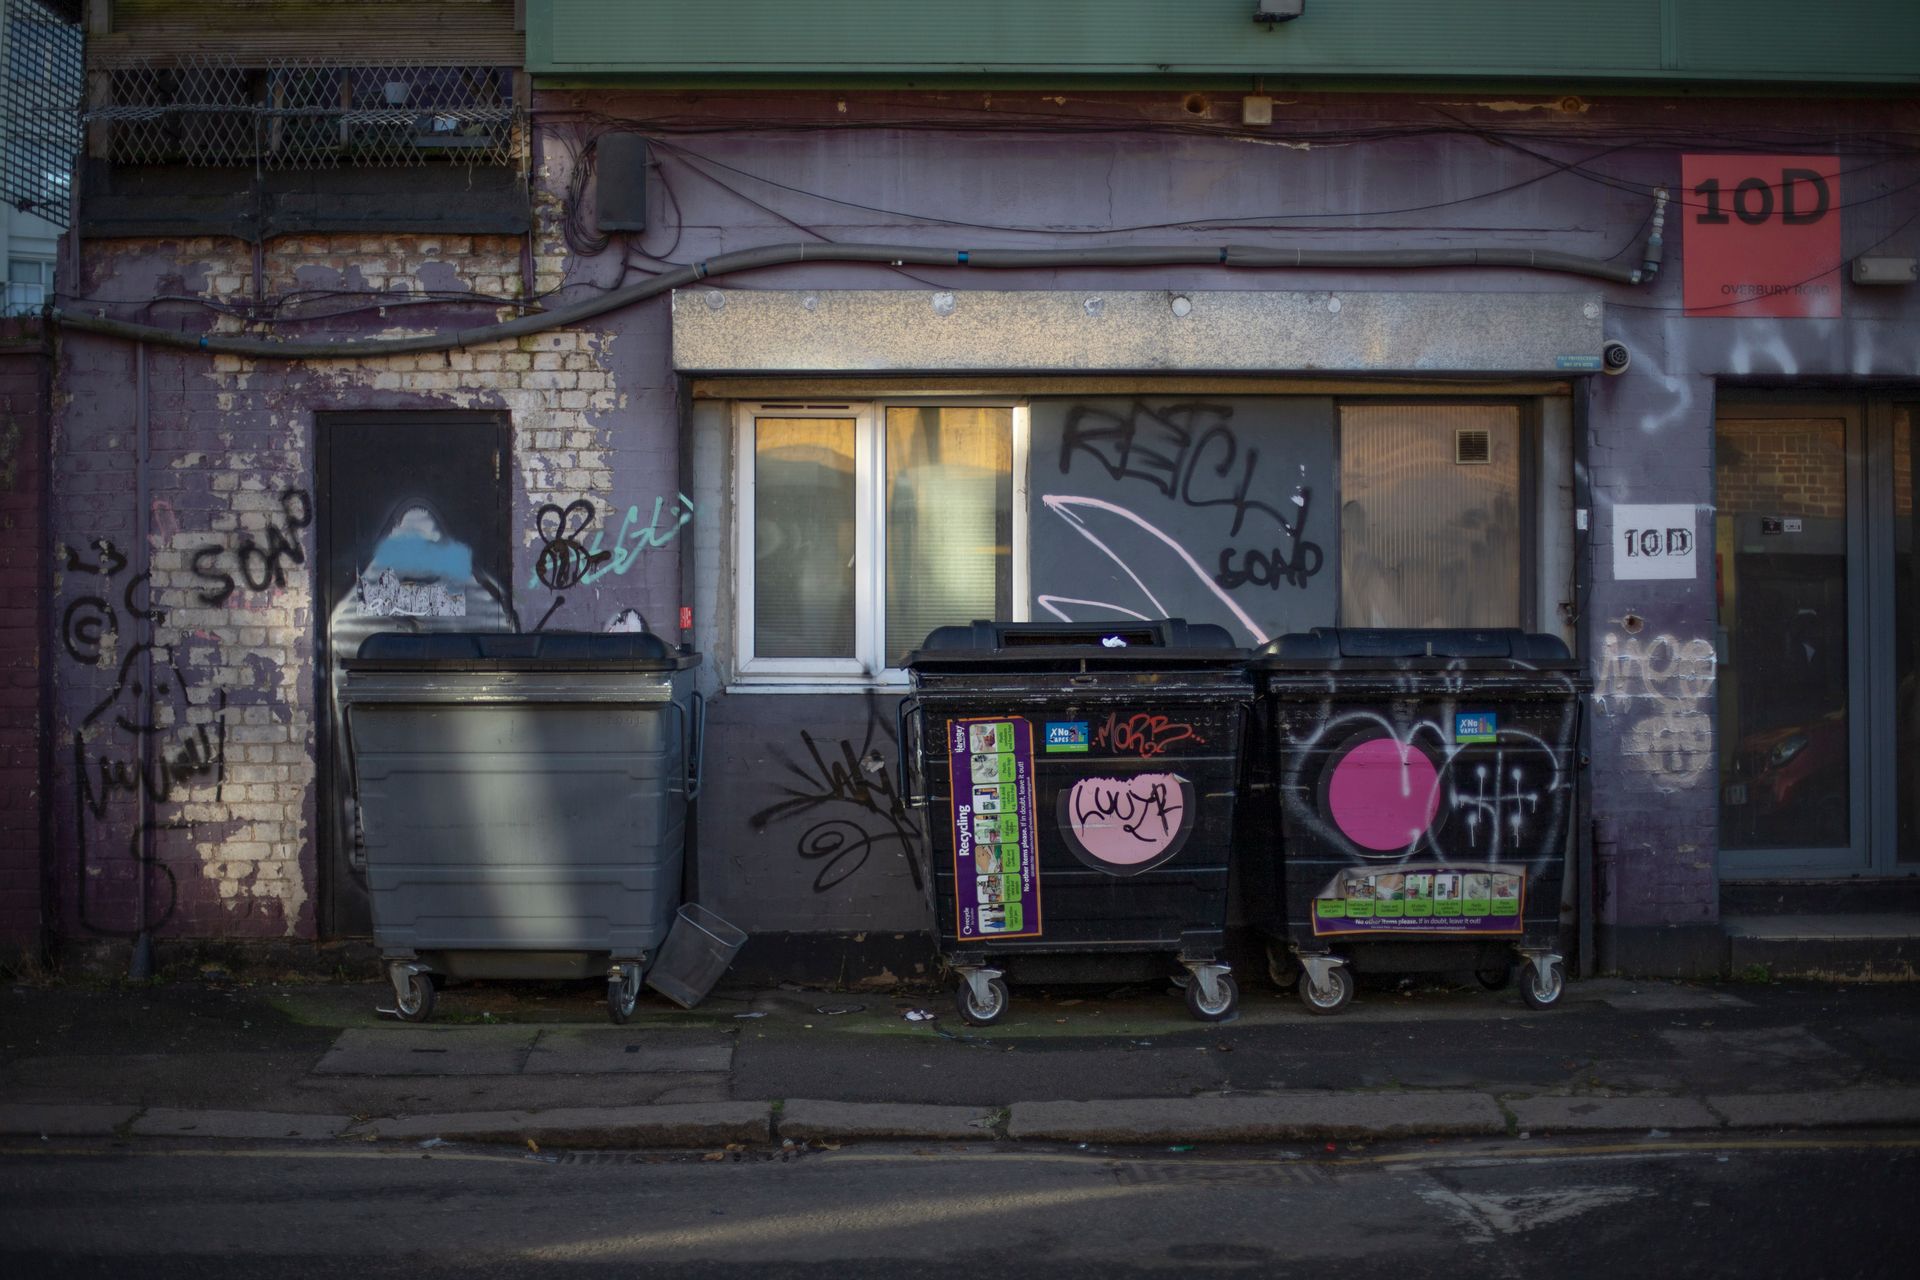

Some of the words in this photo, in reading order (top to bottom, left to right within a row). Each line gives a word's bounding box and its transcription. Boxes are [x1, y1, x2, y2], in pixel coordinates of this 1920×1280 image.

[1695, 168, 1830, 226] 10D
[1721, 284, 1790, 296] OVERBURY
[1624, 527, 1693, 557] 10D
[954, 725, 965, 753] Haringey
[958, 804, 972, 856] Recycling
[1021, 827, 1029, 848] please.
[1023, 883, 1030, 892] No
